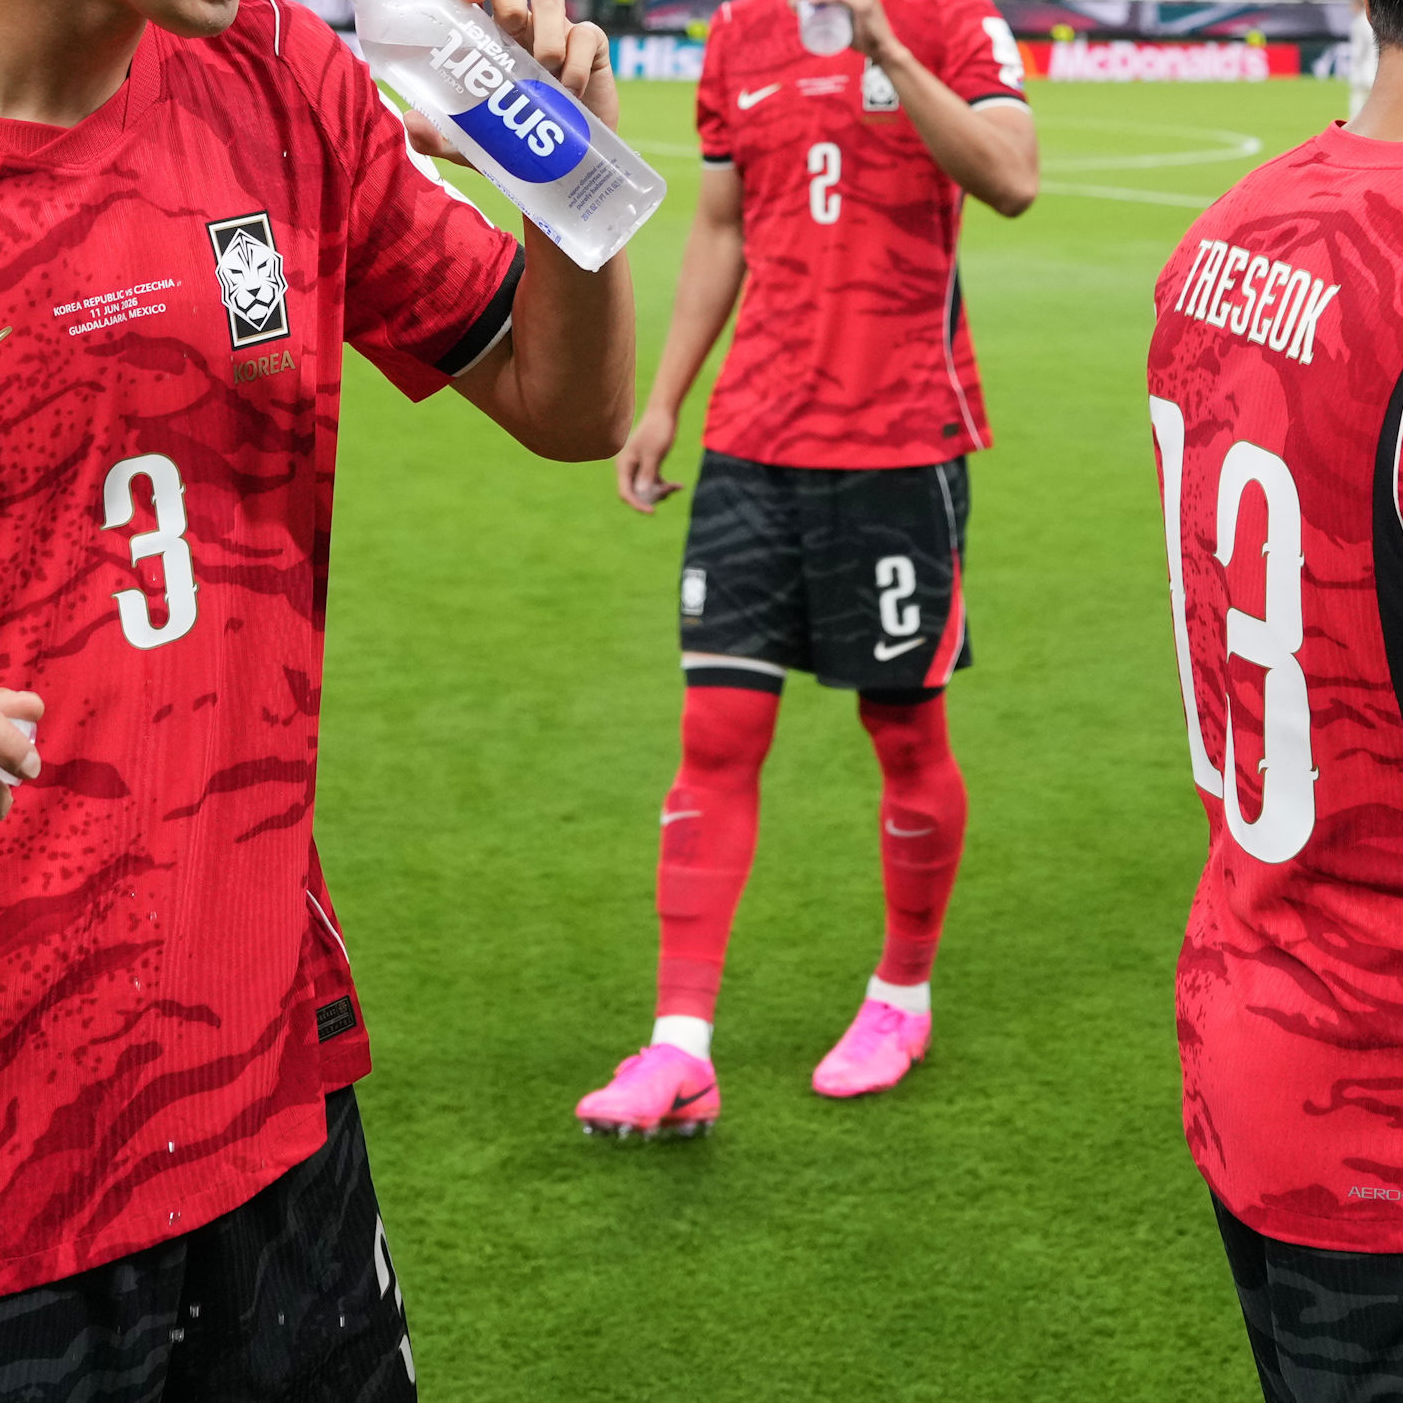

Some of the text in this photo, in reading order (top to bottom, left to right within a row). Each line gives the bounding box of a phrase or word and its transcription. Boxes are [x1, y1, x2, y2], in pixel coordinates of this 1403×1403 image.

[459, 20, 518, 72] water
[1048, 39, 1270, 82] McDonald's
[429, 29, 565, 157] smart
[807, 142, 842, 225] 2
[53, 278, 175, 317] KOREA REPUBLIC vs CZECHIA
[68, 302, 167, 337] GUADALAJARA, MEXICO
[89, 297, 139, 319] 11 JUN 2026
[1174, 238, 1341, 365] TAESEOK
[233, 350, 296, 385] KOREA
[99, 452, 199, 651] 3
[875, 554, 921, 637] 2
[1149, 394, 1319, 864] 13
